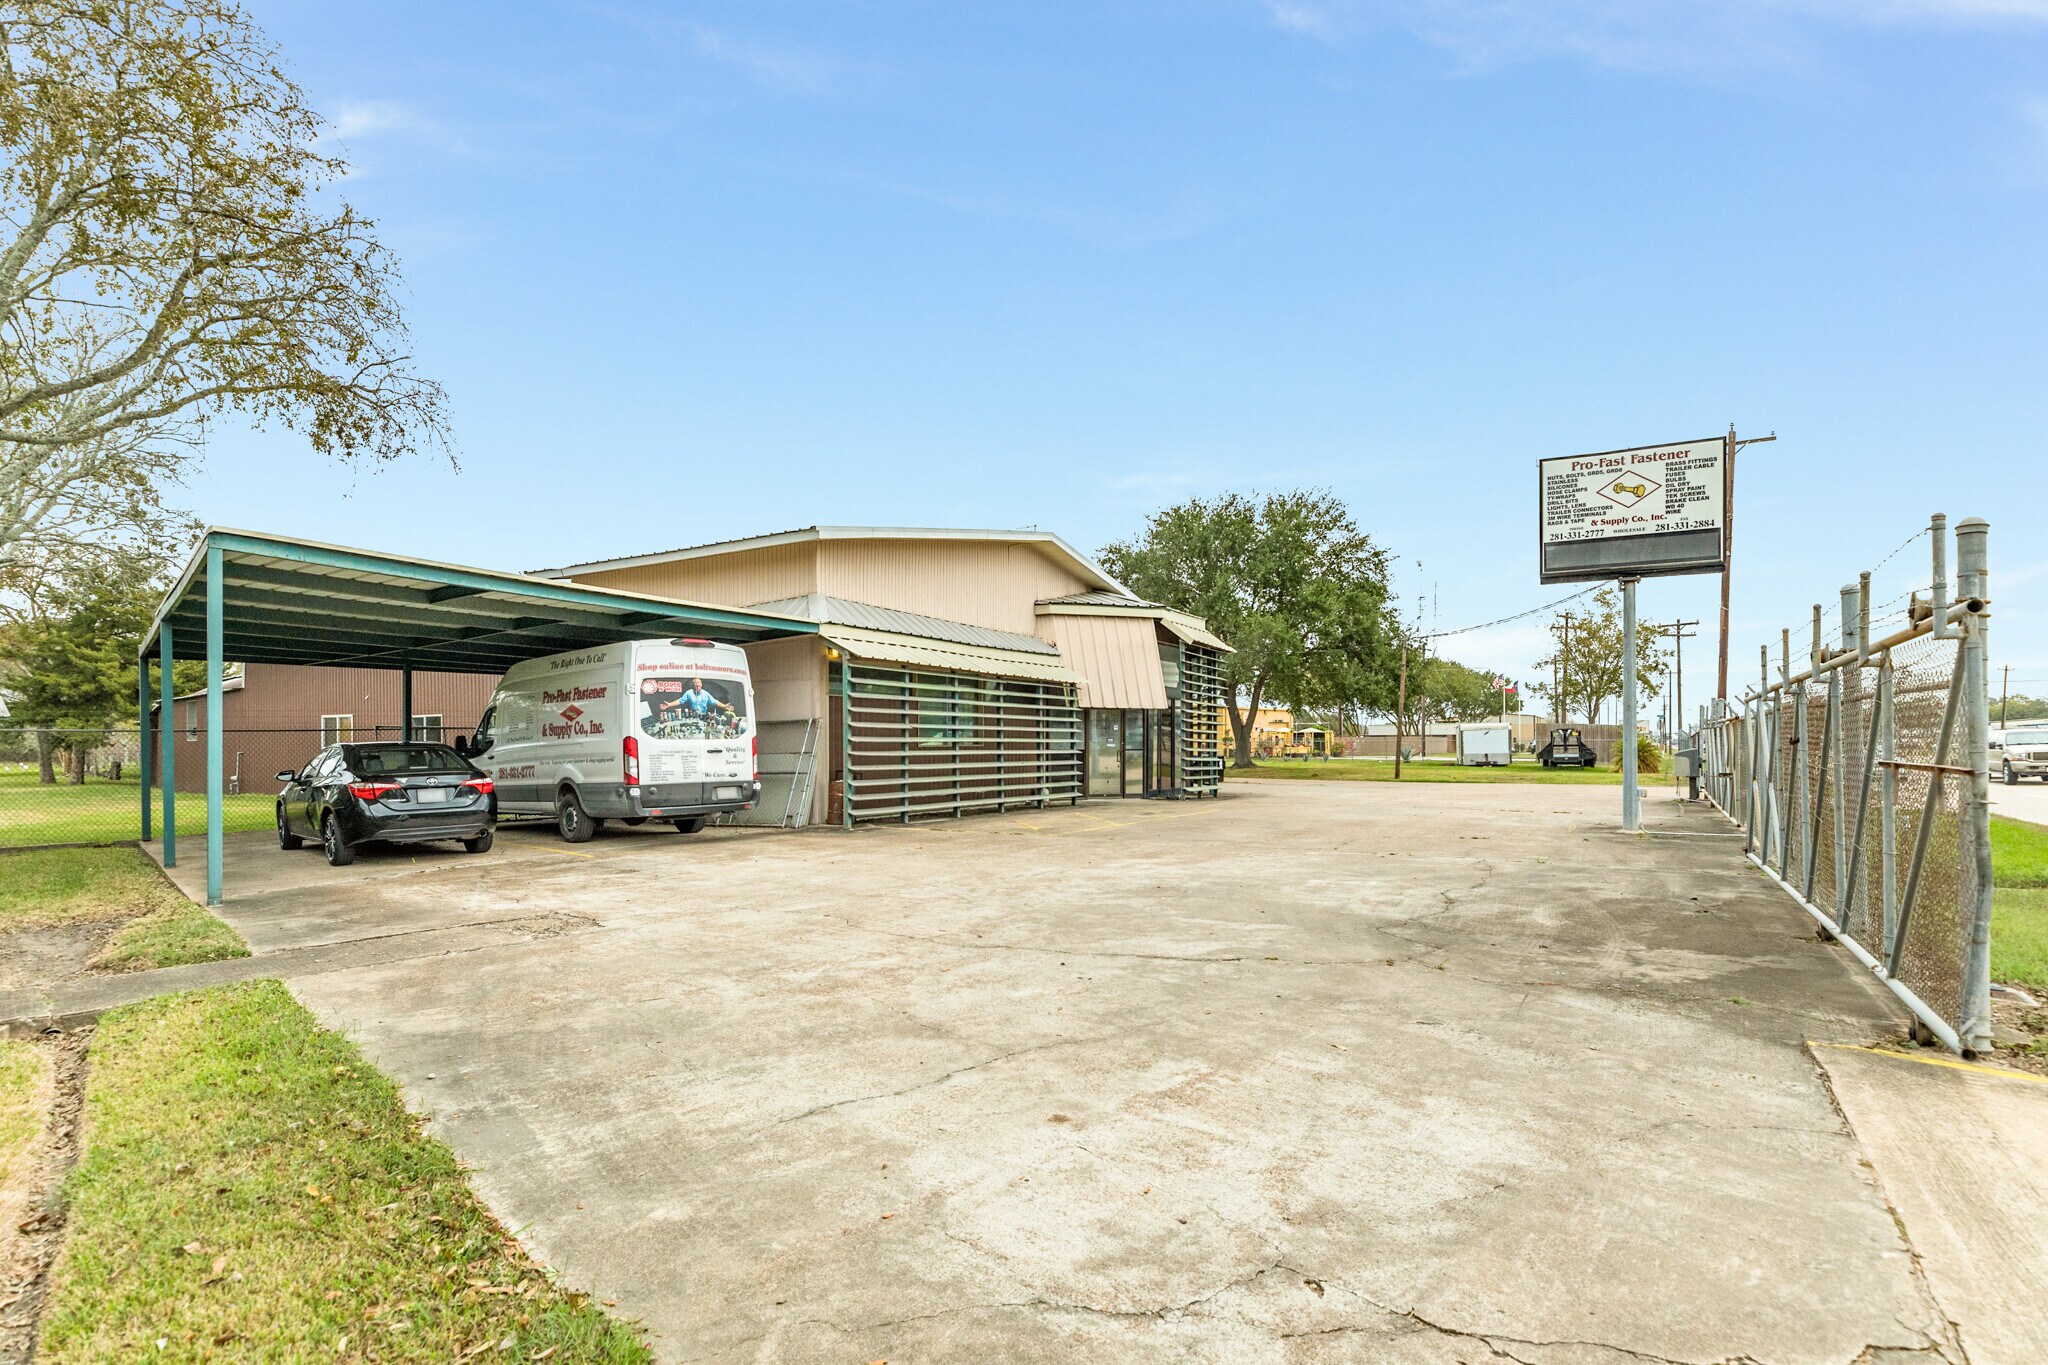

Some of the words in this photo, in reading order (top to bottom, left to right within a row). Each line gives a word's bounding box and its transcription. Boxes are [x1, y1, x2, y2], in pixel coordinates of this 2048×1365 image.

[1572, 456, 1626, 471] Pro-Fast
[1631, 450, 1691, 464] Fastener
[1573, 505, 1613, 513] CONNECTORS
[1601, 517, 1629, 525] Supply
[1655, 519, 1715, 532] 281-331-2884
[1549, 529, 1604, 541] 281-331-2777
[560, 658, 574, 669] Right
[575, 657, 585, 665] One
[586, 655, 592, 664] To
[637, 663, 657, 672] Shop
[542, 688, 572, 704] Pro-Fast
[572, 686, 607, 701] Fastener
[542, 724, 547, 737] &
[548, 721, 572, 739] Supply
[574, 721, 588, 736] Co.,
[589, 720, 604, 734] Inc.
